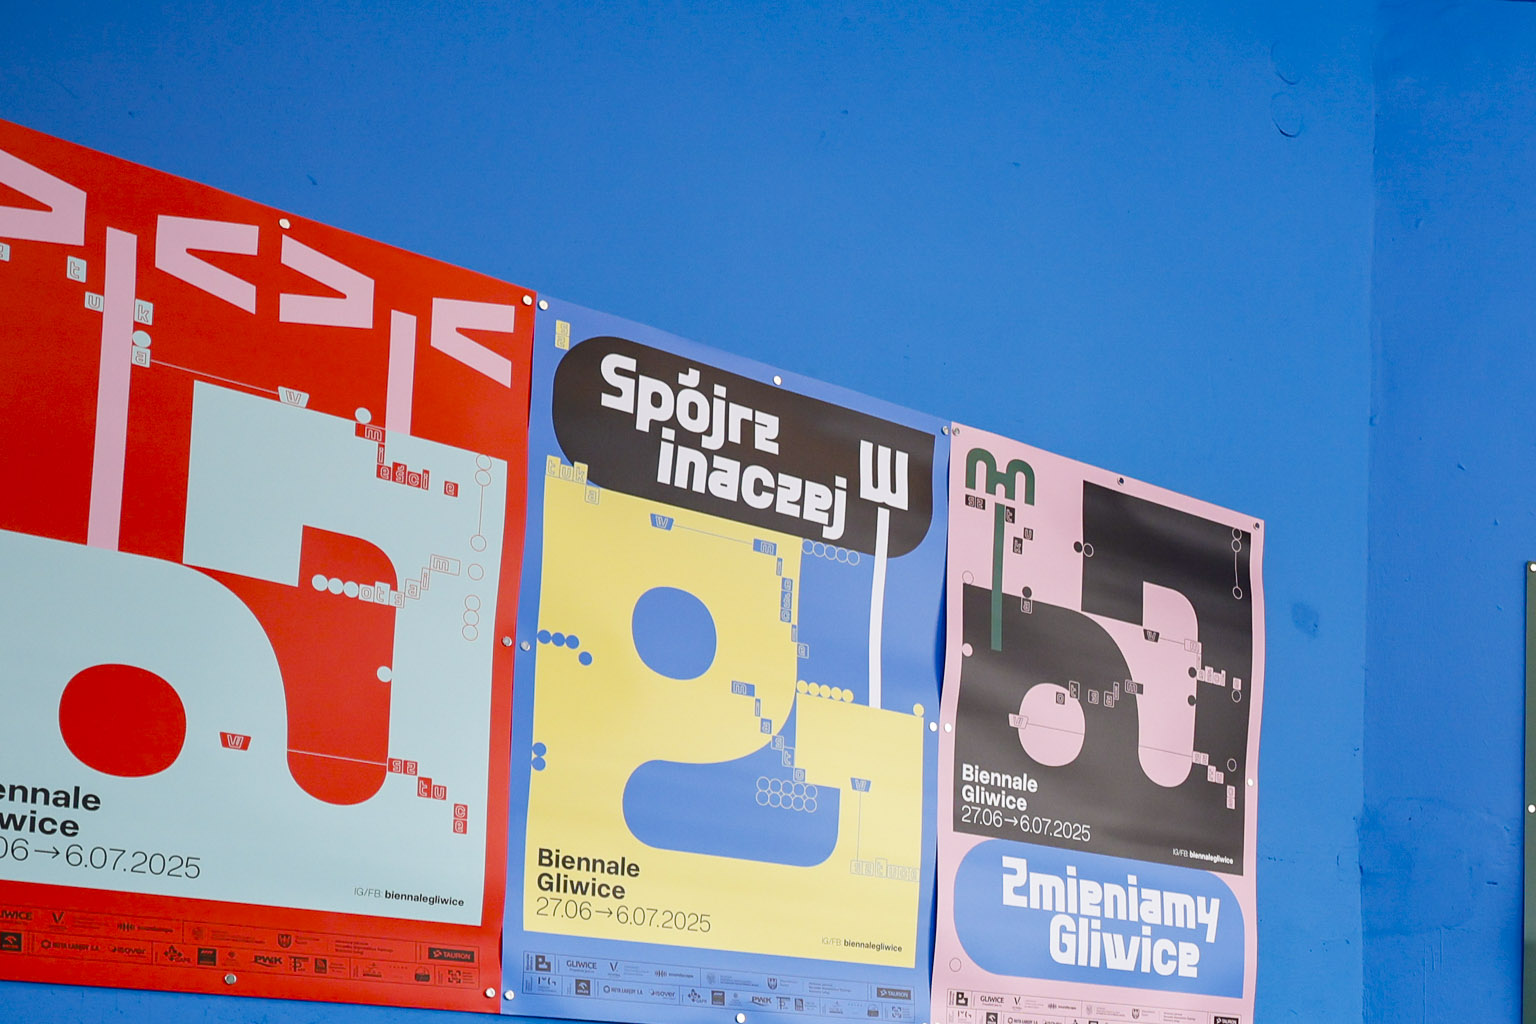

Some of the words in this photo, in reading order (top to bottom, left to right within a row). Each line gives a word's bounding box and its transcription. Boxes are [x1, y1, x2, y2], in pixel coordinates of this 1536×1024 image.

[600, 353, 779, 455] Spójrz
[657, 427, 847, 540] inaczej
[961, 763, 1038, 793] Biennale
[961, 785, 1027, 812] Gliwice
[537, 848, 640, 878] Biennale
[1189, 850, 1234, 865] biennalegliwice
[384, 890, 465, 906] biennalegliwice
[537, 873, 626, 900] Gliwice
[1002, 855, 1220, 943] Zmieniamy
[843, 938, 903, 953] biennalegliwice
[1050, 913, 1200, 978] Gliwice
